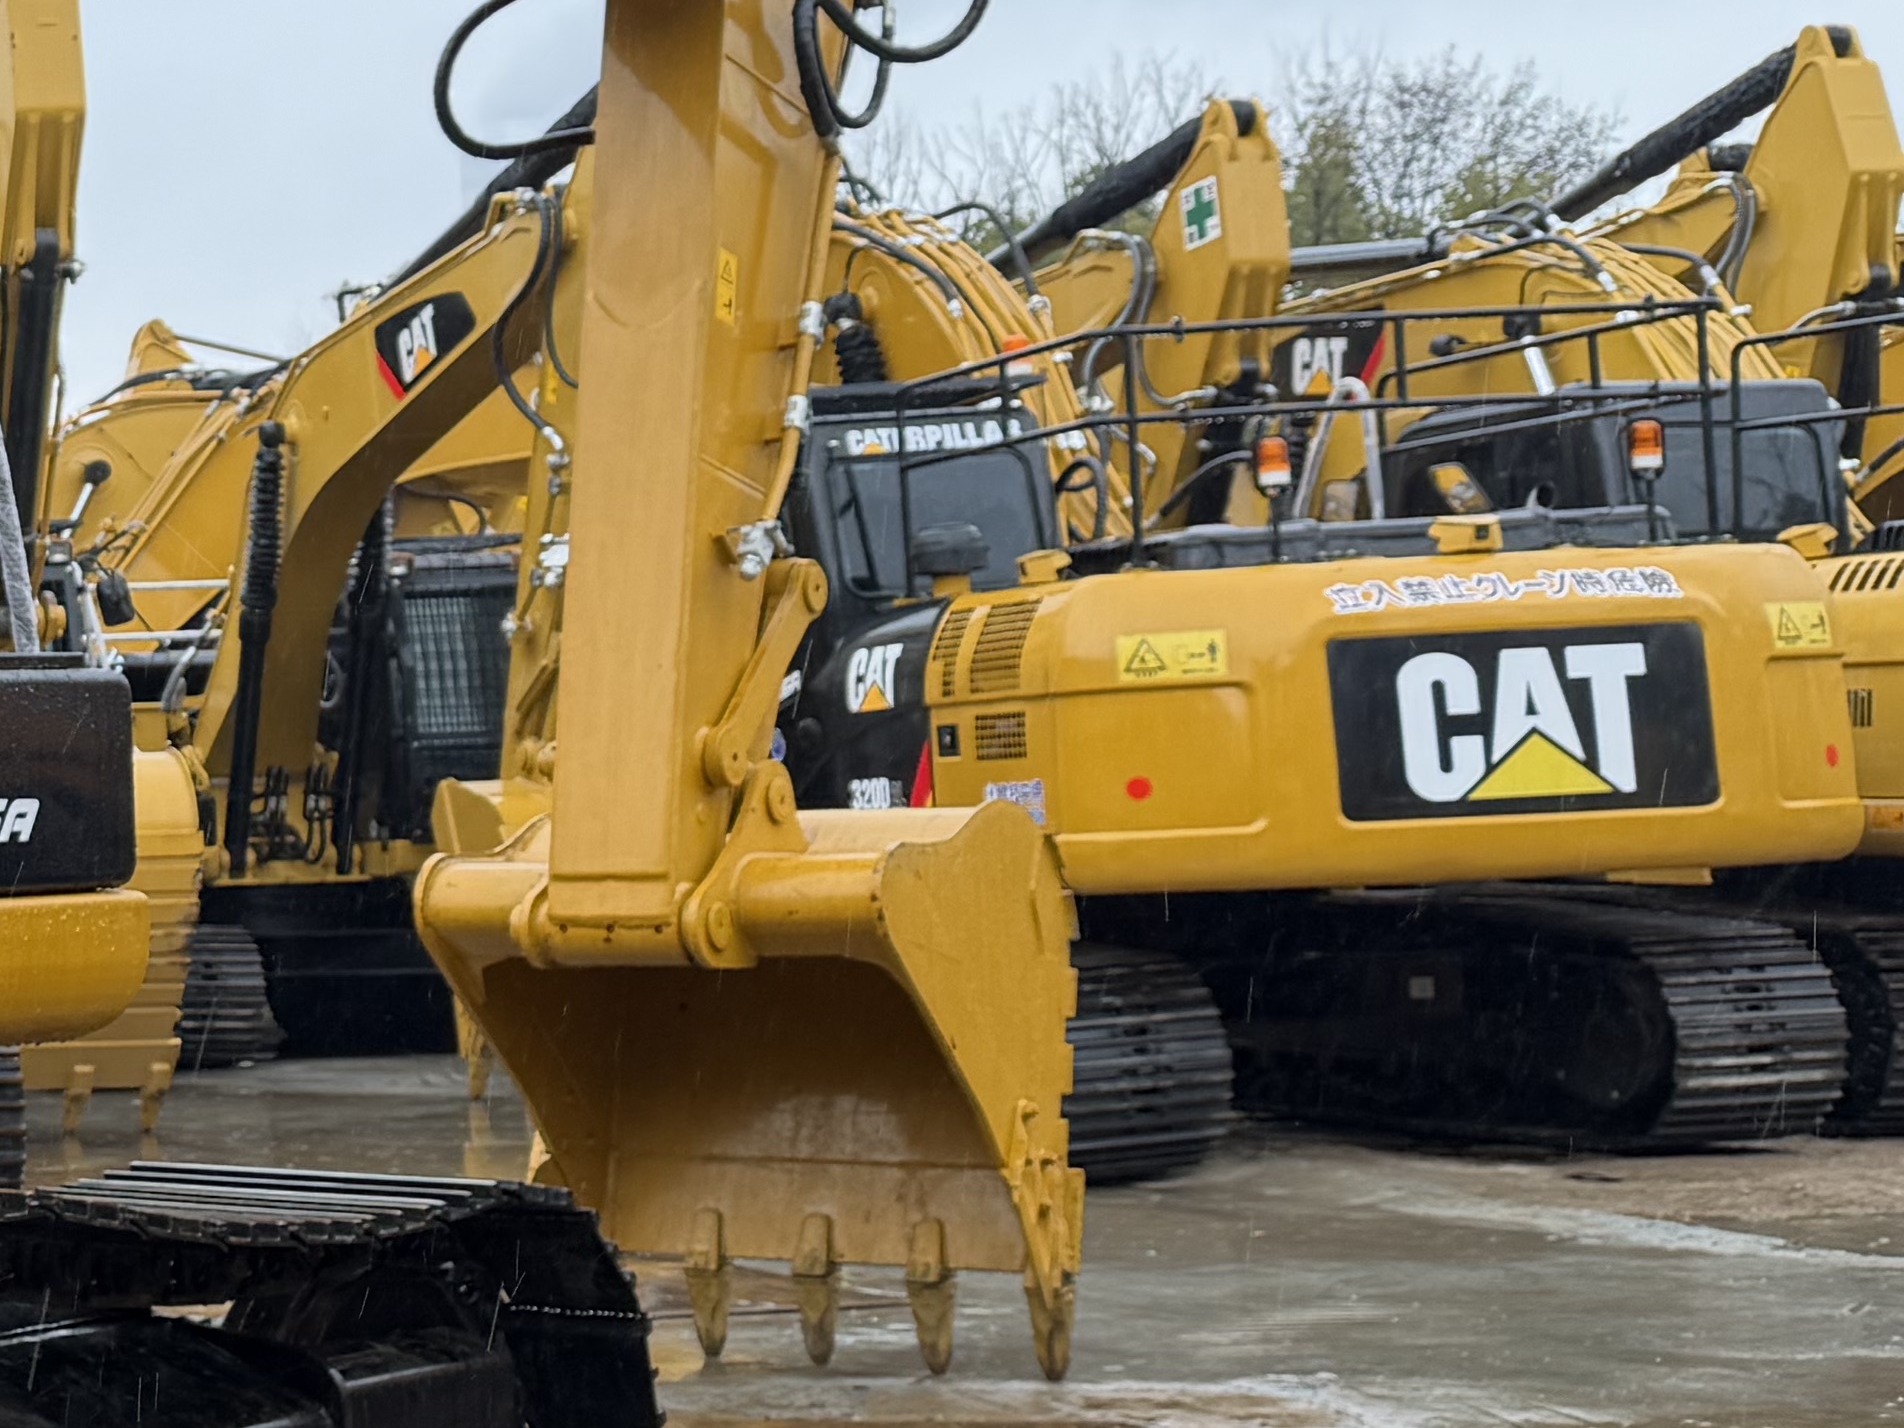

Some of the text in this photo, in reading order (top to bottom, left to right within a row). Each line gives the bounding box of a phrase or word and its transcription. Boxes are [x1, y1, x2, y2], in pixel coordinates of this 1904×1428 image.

[398, 303, 438, 384] CAT
[1292, 336, 1348, 396] CAT
[847, 643, 904, 714] CAT
[1396, 642, 1647, 803] CAT
